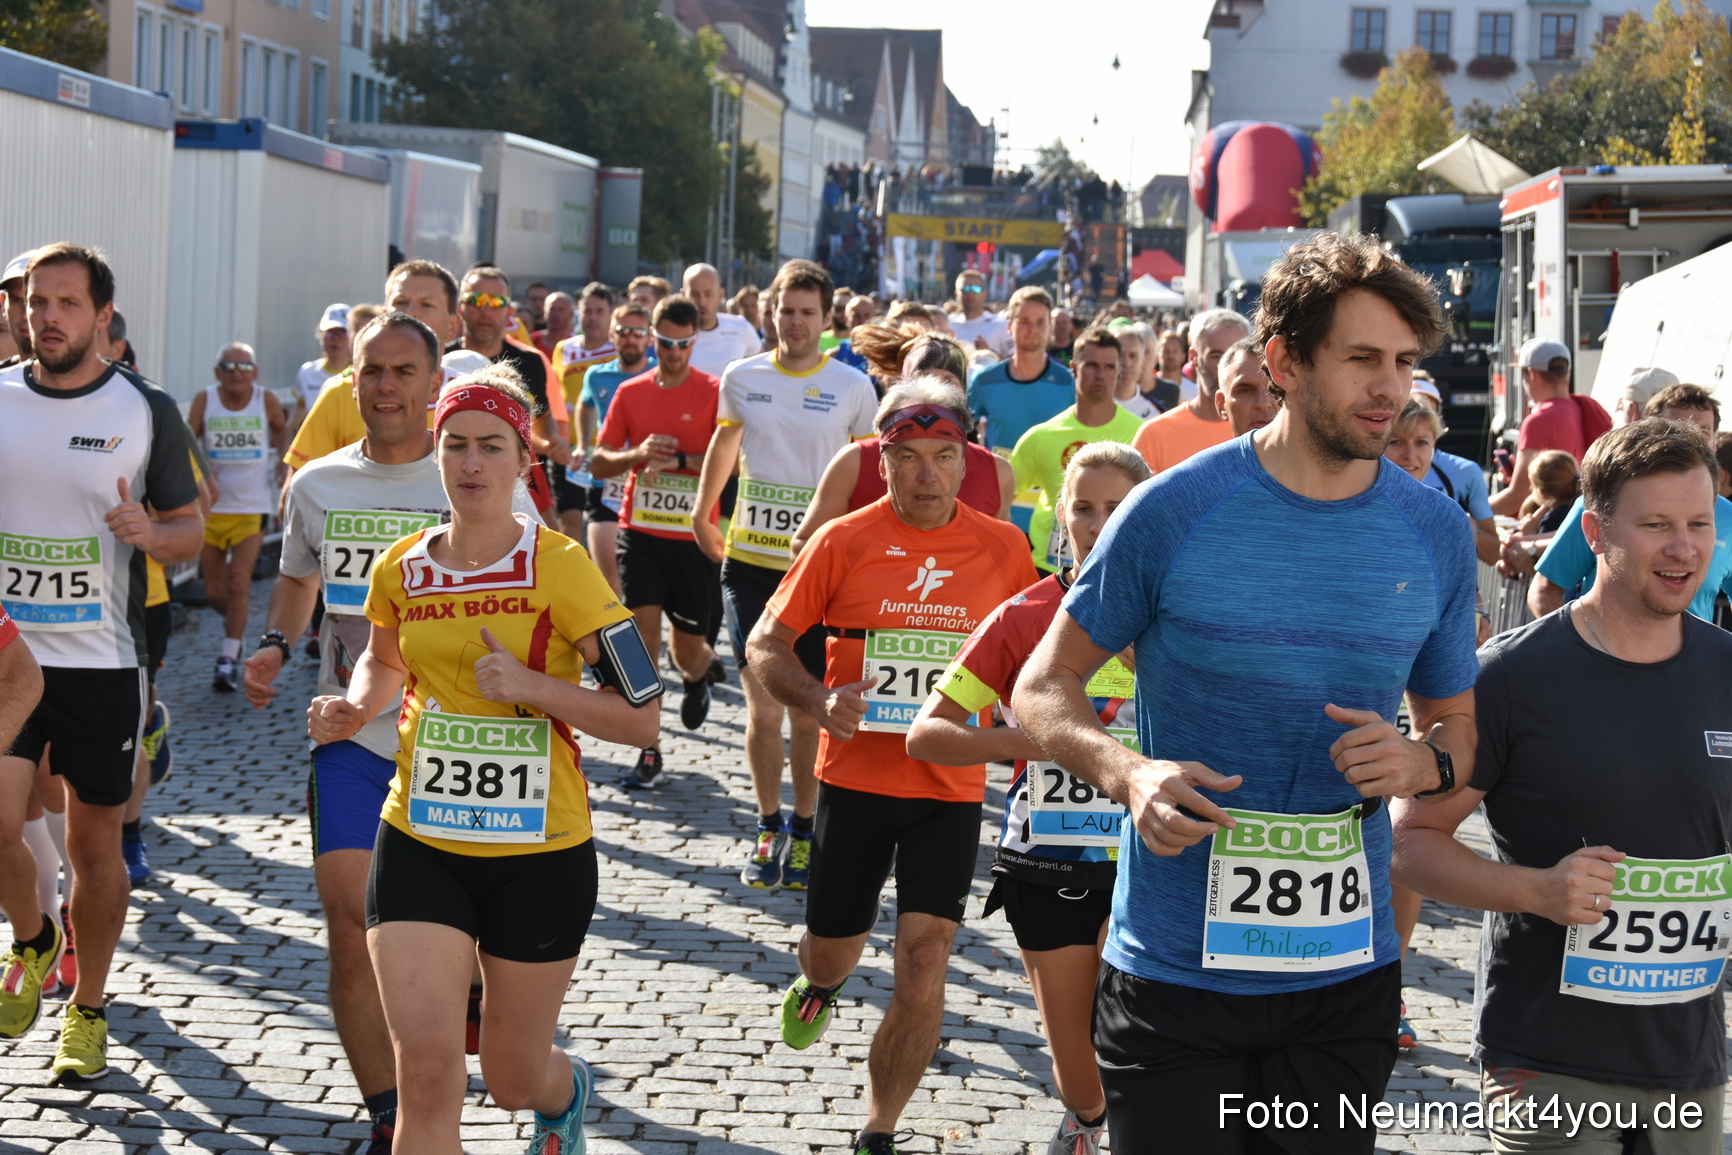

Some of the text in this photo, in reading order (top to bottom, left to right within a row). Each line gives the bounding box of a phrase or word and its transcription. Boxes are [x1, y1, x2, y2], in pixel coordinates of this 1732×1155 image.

[944, 222, 1006, 238] START
[804, 387, 820, 398] 20
[69, 436, 106, 448] swn
[213, 432, 257, 448] 2084
[641, 490, 690, 512] 1204
[746, 483, 812, 504] BOCK
[332, 516, 426, 536] BOCK
[642, 512, 685, 525] DOMINIK
[4, 538, 92, 562] BOCK
[885, 549, 907, 557] erima
[334, 546, 388, 579] 27
[6, 567, 90, 599] 2715
[11, 602, 70, 622] Fabian
[403, 594, 537, 623] MAX BÖGL
[878, 599, 967, 618] funrunners
[905, 614, 978, 631] neumarkt
[425, 719, 534, 750] BOCK
[423, 756, 529, 800] 2381
[1230, 820, 1354, 852] BOCK
[1000, 852, 1074, 872] www.bmw-partl.de
[1229, 865, 1362, 917] 2818
[1588, 910, 1719, 954] 2594
[1241, 928, 1333, 961] Philipp
[1587, 964, 1708, 989] GÜNTHER
